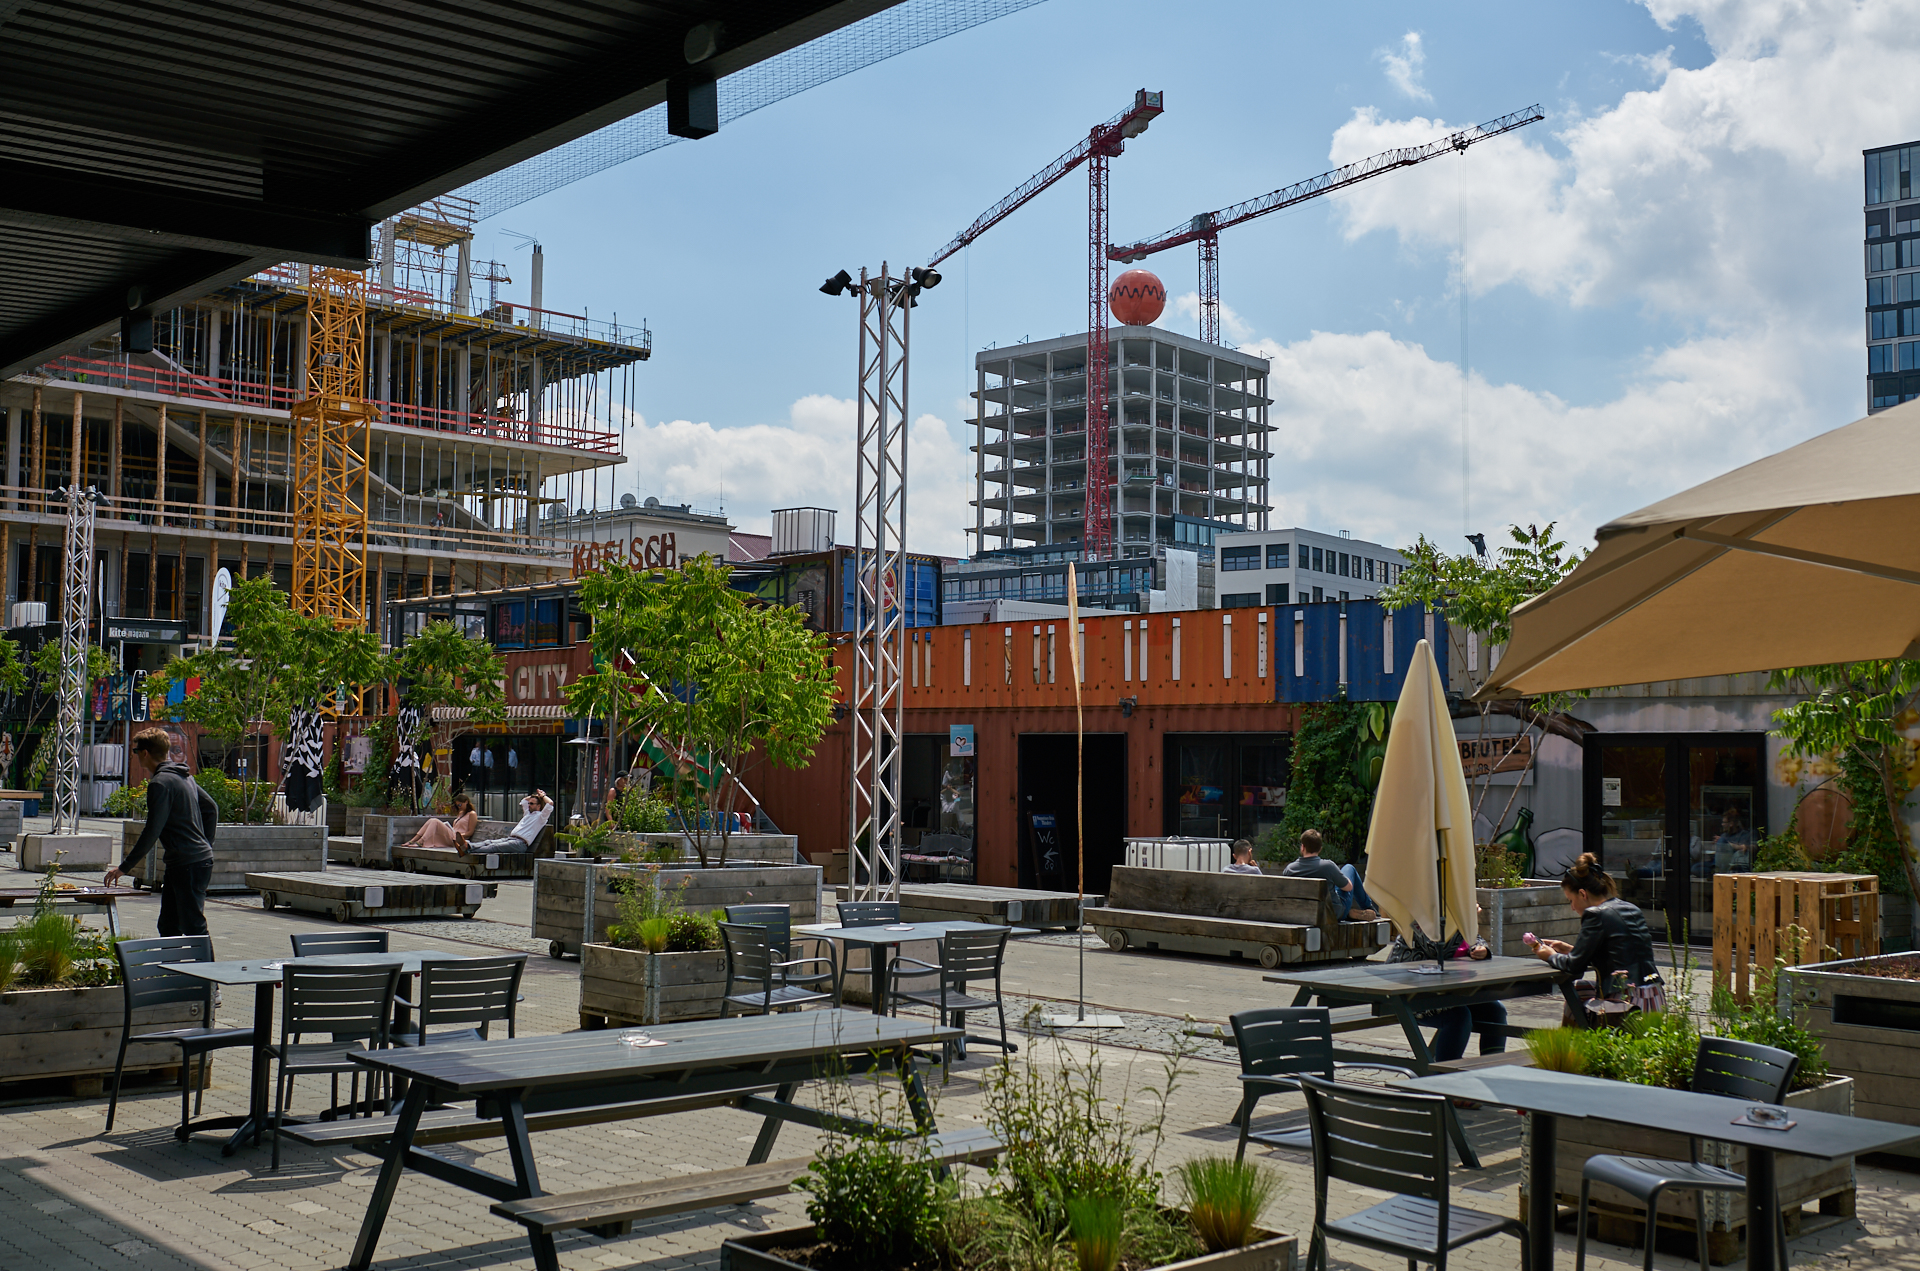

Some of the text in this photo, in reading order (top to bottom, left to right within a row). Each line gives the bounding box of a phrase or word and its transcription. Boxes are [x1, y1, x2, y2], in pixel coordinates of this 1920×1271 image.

[109, 627, 127, 638] kite
[512, 663, 567, 700] CITY
[1458, 738, 1522, 759] BEUTEL
